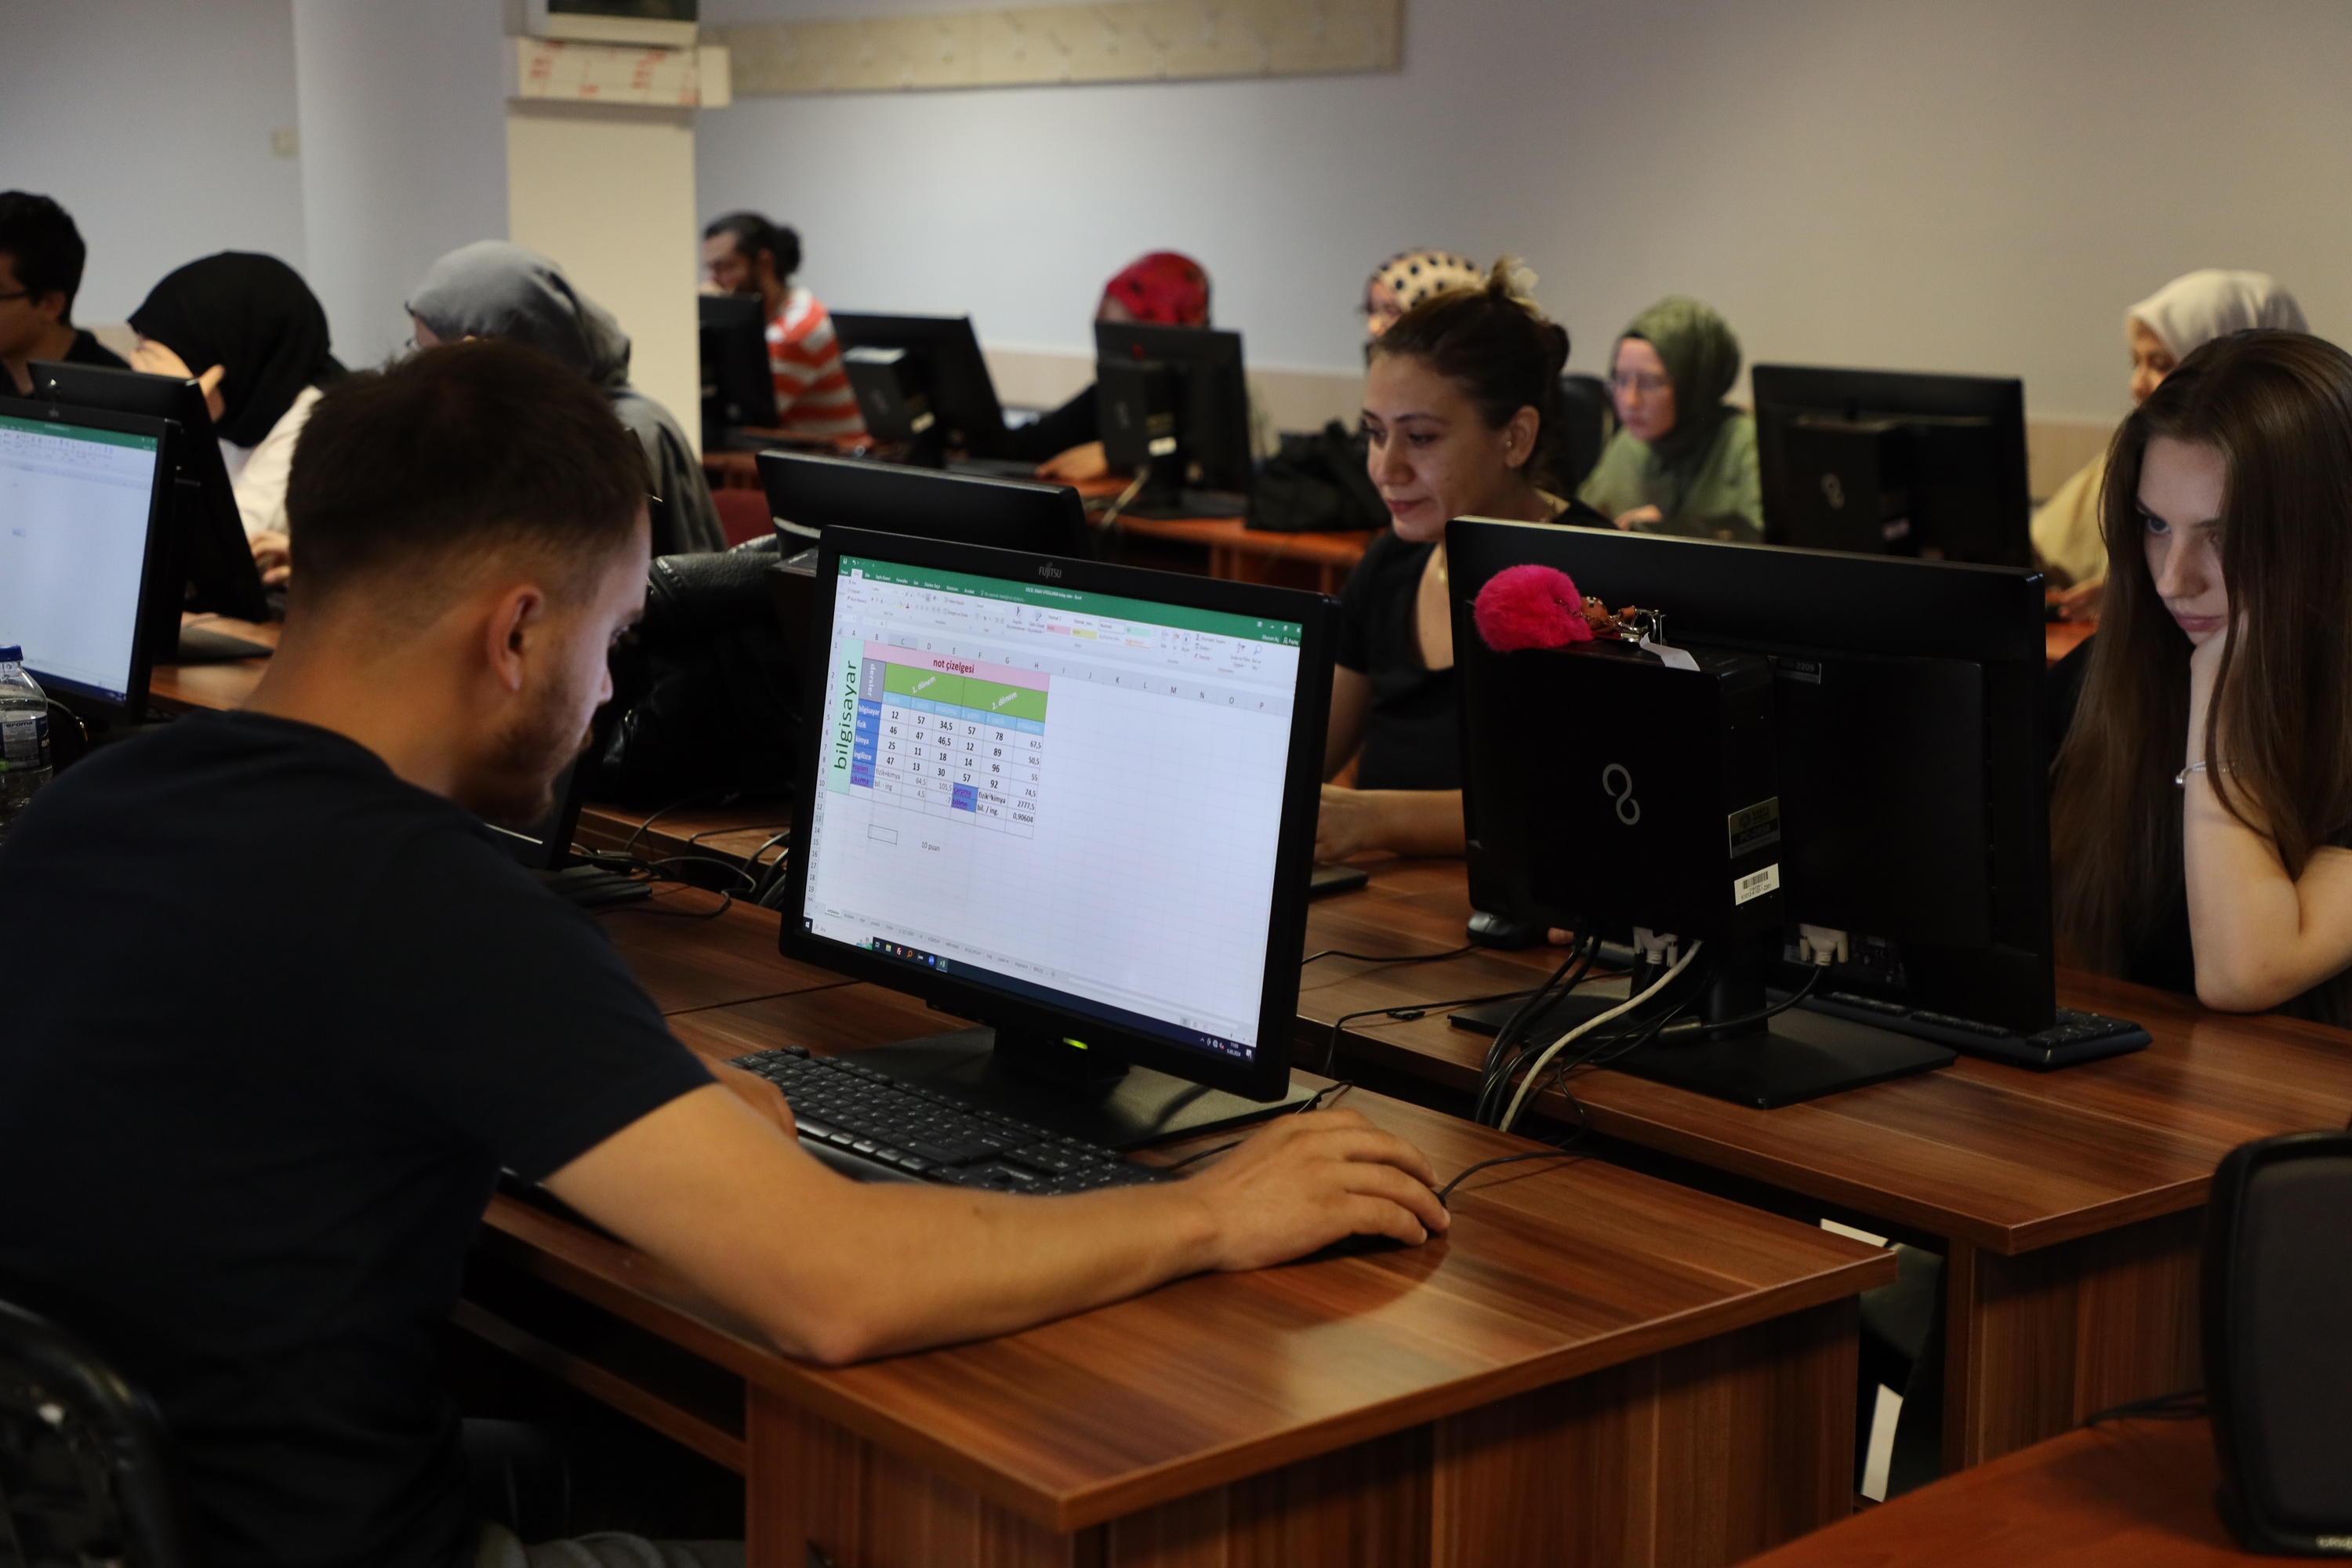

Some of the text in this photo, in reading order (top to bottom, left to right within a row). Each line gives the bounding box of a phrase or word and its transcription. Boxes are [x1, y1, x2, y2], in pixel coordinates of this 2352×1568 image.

[1039, 564, 1062, 579] FUJITSU
[934, 659, 975, 673] not çizelgesi
[867, 663, 877, 697] dersler
[917, 676, 936, 691] dönem
[998, 691, 1018, 706] dönem
[834, 660, 857, 770] bilgisayar
[858, 706, 880, 716] bilgisayar
[891, 711, 899, 720] 12
[857, 720, 866, 728] fizik
[940, 721, 953, 731] 34,5
[968, 727, 975, 735] 57
[855, 735, 869, 745] kimya
[938, 736, 951, 746] 46,5
[996, 732, 1004, 741] 78
[967, 742, 974, 751] 12
[915, 747, 921, 756] 11
[994, 748, 1002, 757] 89
[887, 757, 895, 765] 47
[939, 753, 947, 761] 18
[1029, 757, 1040, 765] 50,5
[913, 762, 920, 771] 13
[964, 758, 972, 767] 14
[853, 764, 869, 772] toplam
[938, 768, 946, 777] 30
[993, 764, 1000, 773] 96
[876, 768, 900, 780] fizik+kimya
[963, 774, 971, 782] 57
[939, 782, 953, 792] 105,5
[991, 780, 998, 789] 92
[953, 787, 971, 797] çarpma
[1025, 789, 1036, 797] 74,5
[952, 798, 967, 808] bölme
[1018, 800, 1035, 811] 2777,5
[985, 805, 989, 814] /
[989, 807, 999, 816] ing.
[1013, 812, 1033, 823] 0,90604
[928, 842, 940, 851] puan
